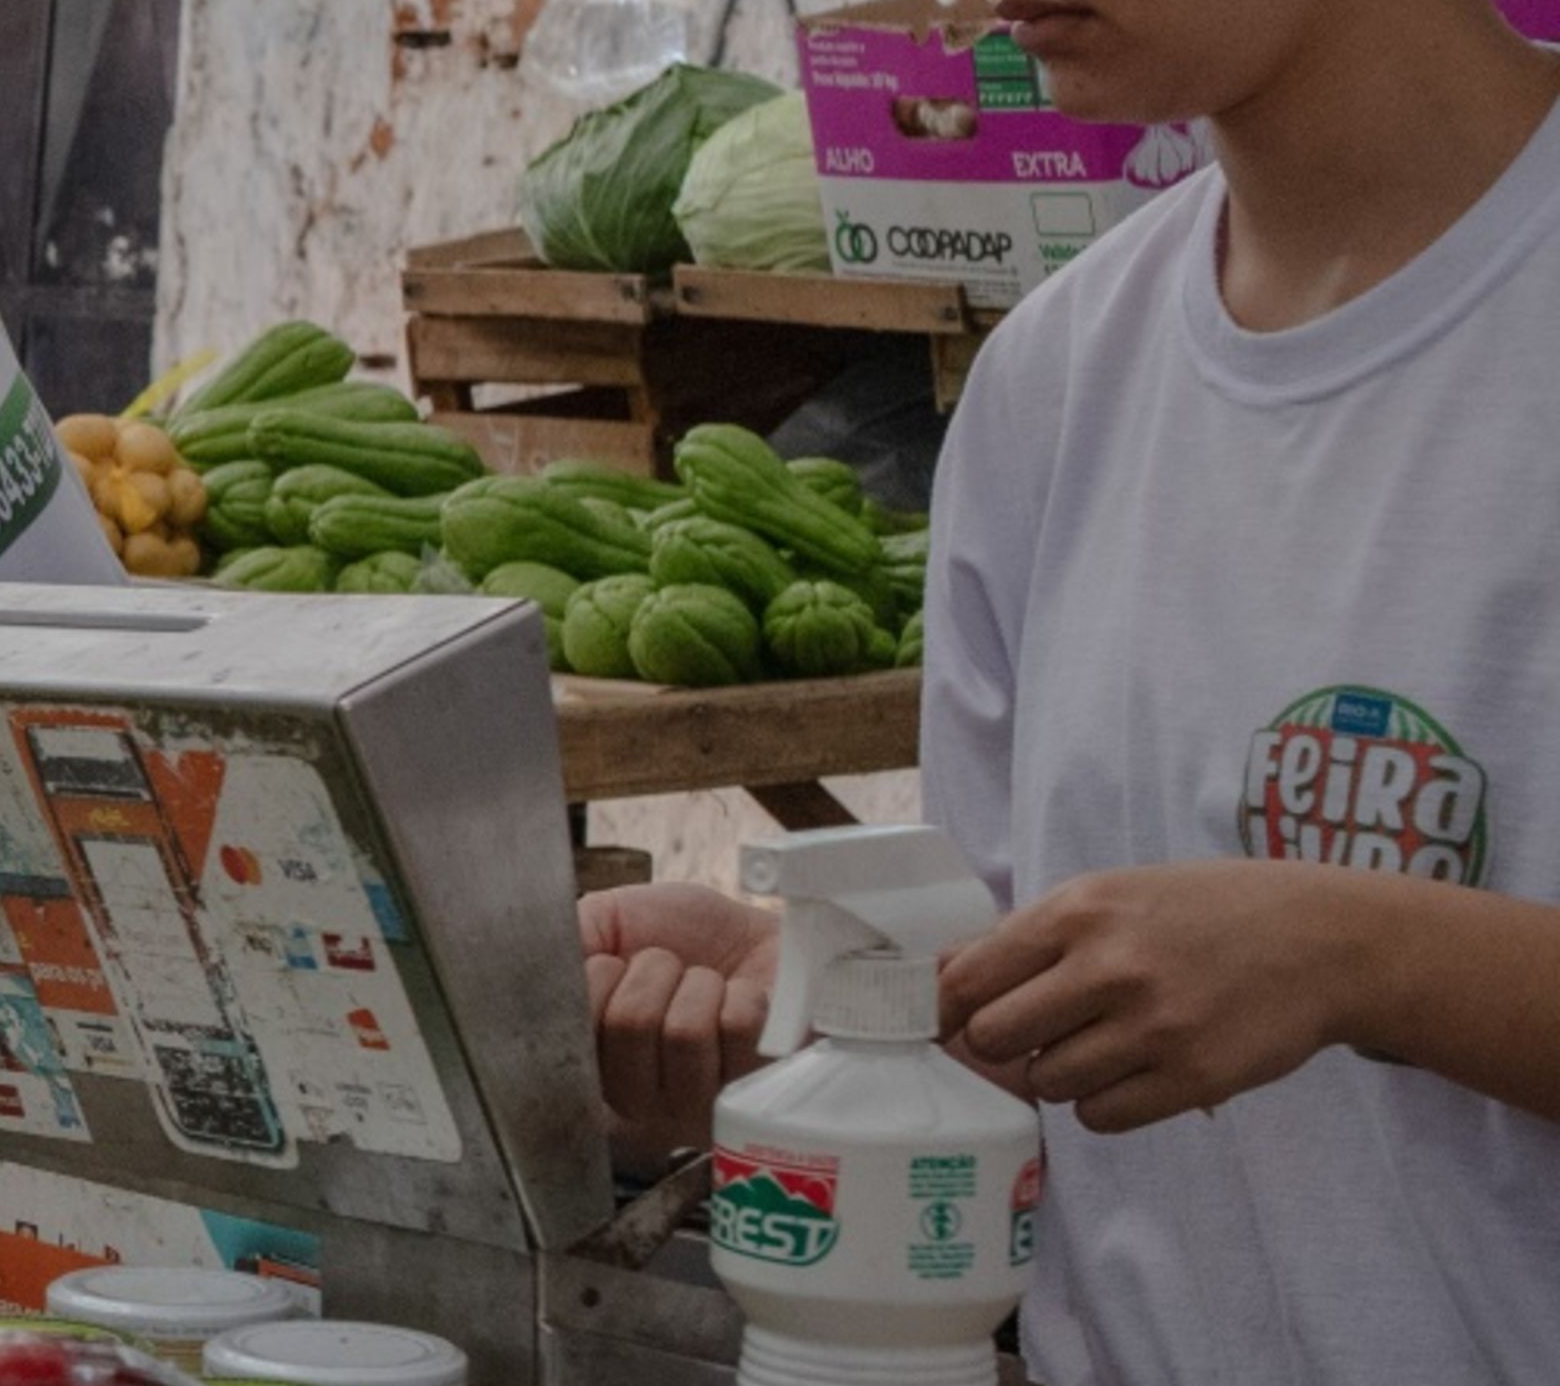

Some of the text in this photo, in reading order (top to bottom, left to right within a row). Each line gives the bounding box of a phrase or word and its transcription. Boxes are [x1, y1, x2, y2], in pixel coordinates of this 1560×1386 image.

[825, 146, 1087, 177] ALHO EXTRA
[887, 225, 1012, 262] COOPADAP
